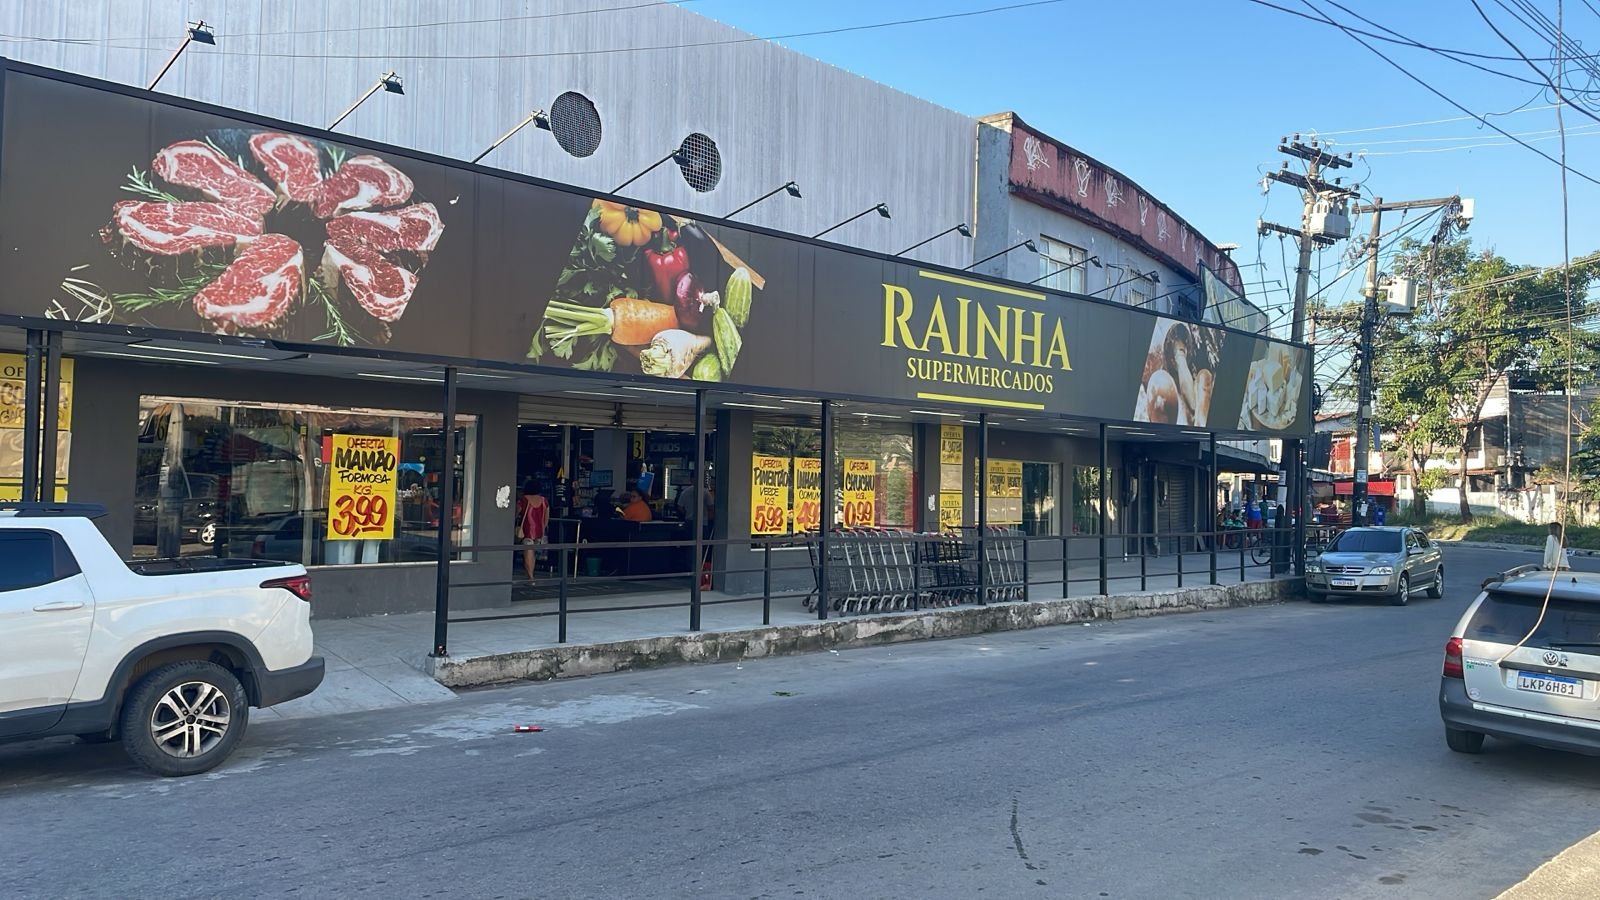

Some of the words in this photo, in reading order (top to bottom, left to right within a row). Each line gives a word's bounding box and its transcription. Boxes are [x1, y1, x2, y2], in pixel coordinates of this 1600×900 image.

[880, 284, 1073, 371] RAINHA
[906, 357, 1053, 394] SUPERMERCADOS
[347, 437, 386, 449] OFERTA
[633, 440, 642, 458] 3
[335, 447, 396, 472] MAMÃO
[338, 470, 391, 484] FORMOSA
[845, 472, 875, 491] CHUCHU
[332, 495, 388, 537] 3,99
[754, 505, 784, 532] 5,98
[1522, 679, 1574, 695] LKP6H81
